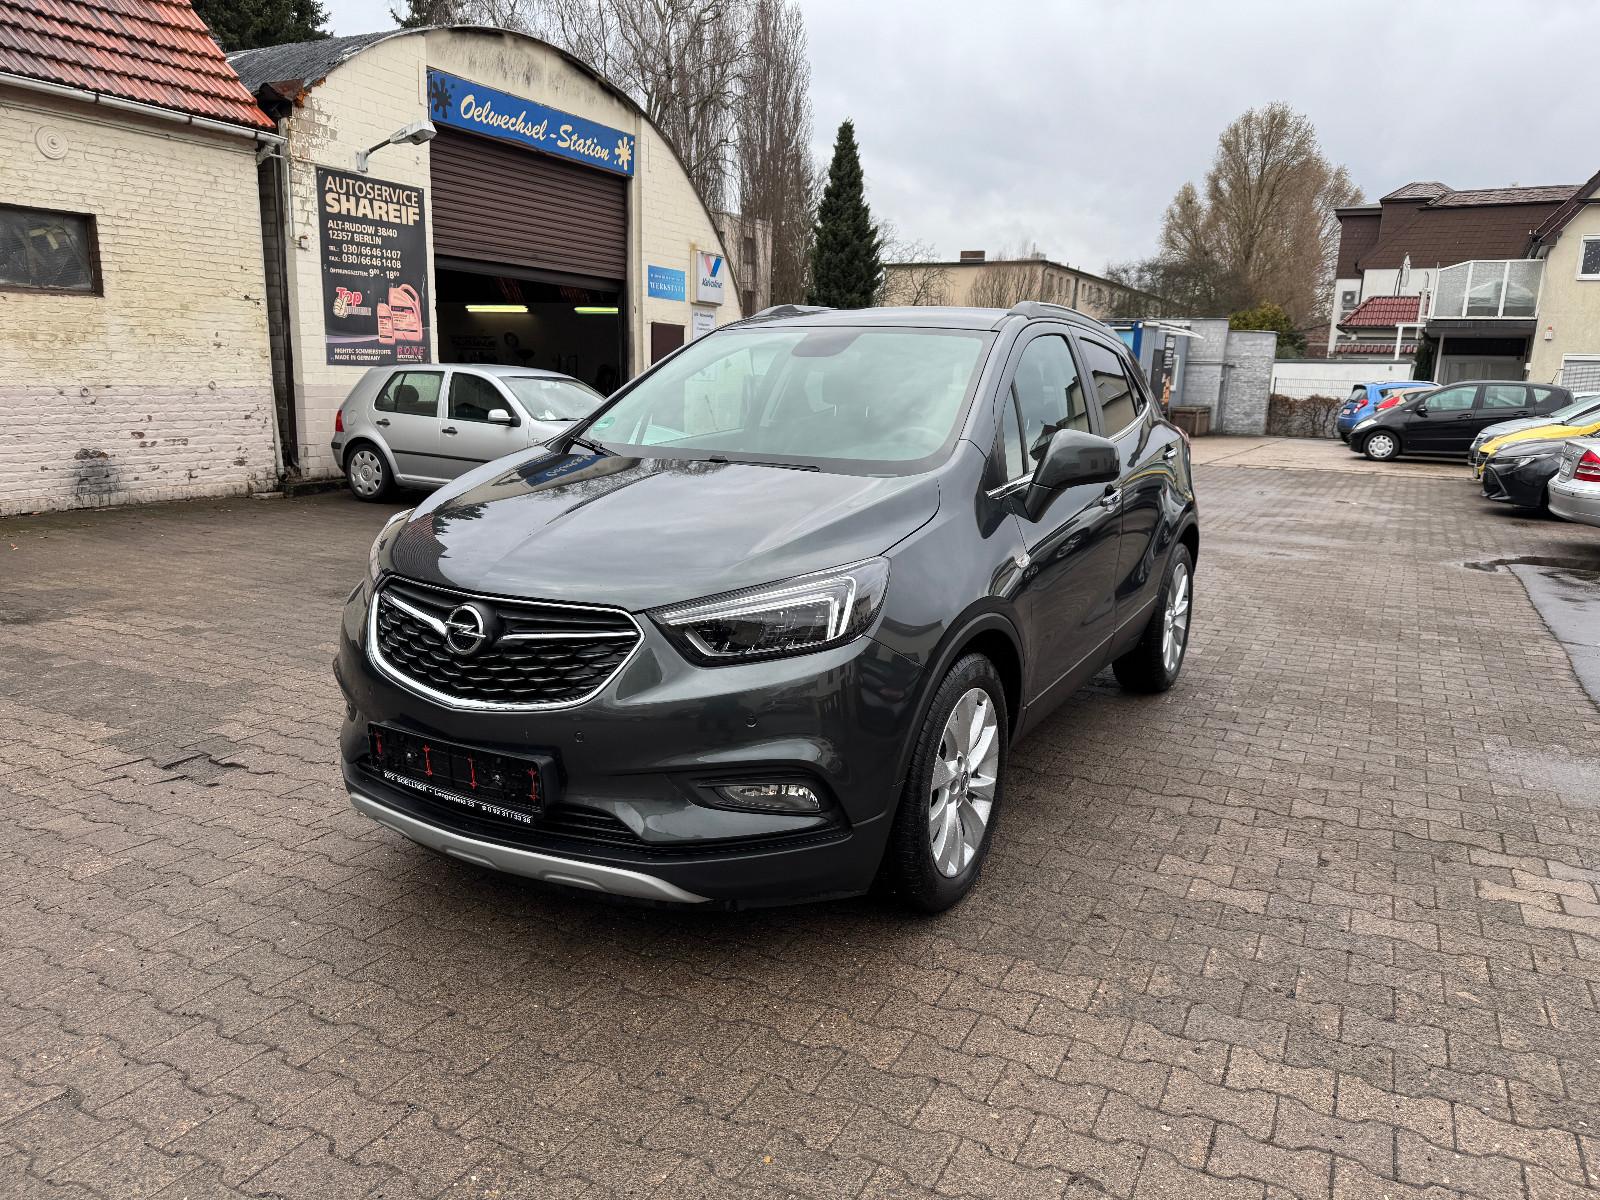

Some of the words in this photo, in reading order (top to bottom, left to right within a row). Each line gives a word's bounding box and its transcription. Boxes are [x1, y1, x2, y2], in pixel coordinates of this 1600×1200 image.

[325, 176, 418, 206] AUTOSERVICE
[326, 193, 419, 225] SHAREIF
[327, 219, 375, 235] ALT-RUDOW
[377, 227, 398, 238] 38/40
[328, 230, 351, 241] 12357
[353, 233, 382, 245] BERLIN
